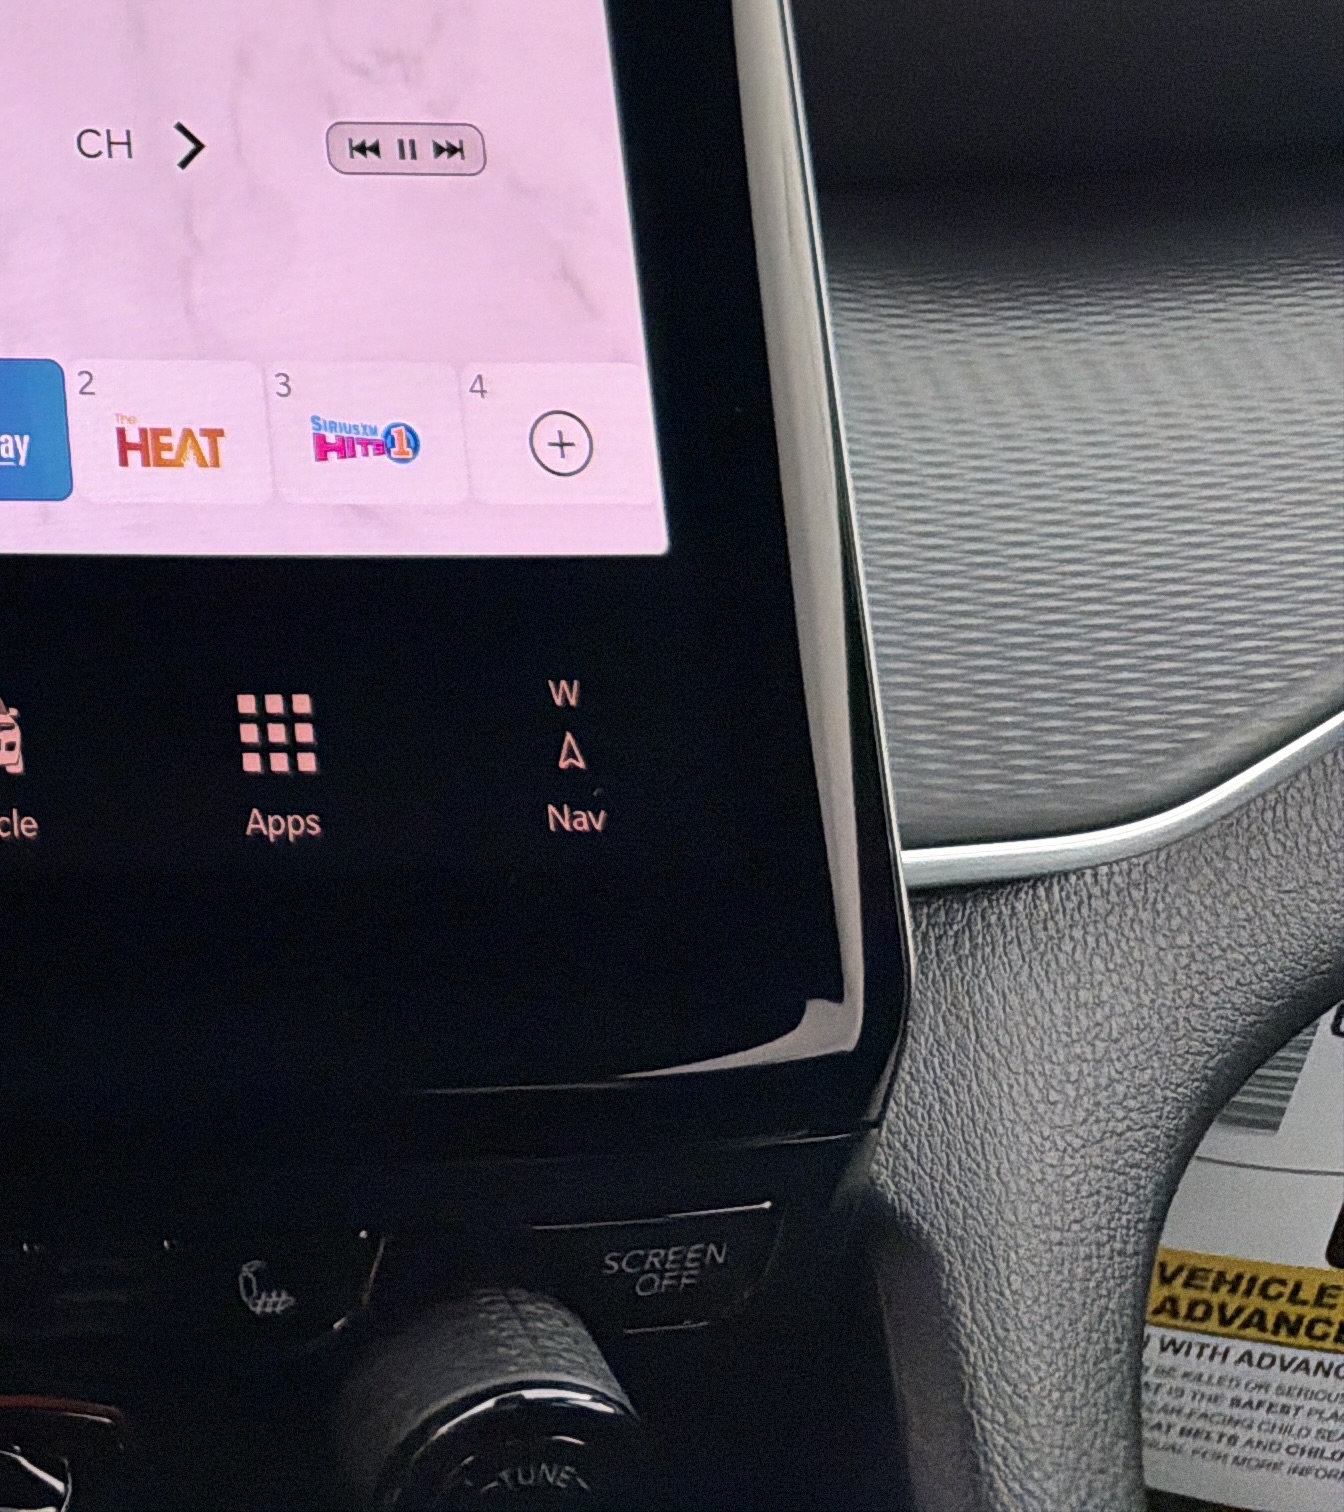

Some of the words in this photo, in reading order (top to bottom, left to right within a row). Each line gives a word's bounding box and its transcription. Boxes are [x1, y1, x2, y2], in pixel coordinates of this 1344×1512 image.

[76, 128, 133, 160] CH
[78, 370, 96, 396] 2
[274, 372, 292, 399] 3
[468, 374, 488, 401] 4
[115, 412, 138, 425] The
[116, 427, 226, 468] HEAT
[547, 679, 581, 708] W
[246, 810, 322, 843] Apps
[547, 805, 607, 834] Nav
[602, 1242, 728, 1274] SCREEN
[635, 1270, 701, 1297] OFF
[1158, 1261, 1344, 1310] VEHICLE
[1159, 1334, 1231, 1364] WITH
[498, 1462, 577, 1489] TUNE
